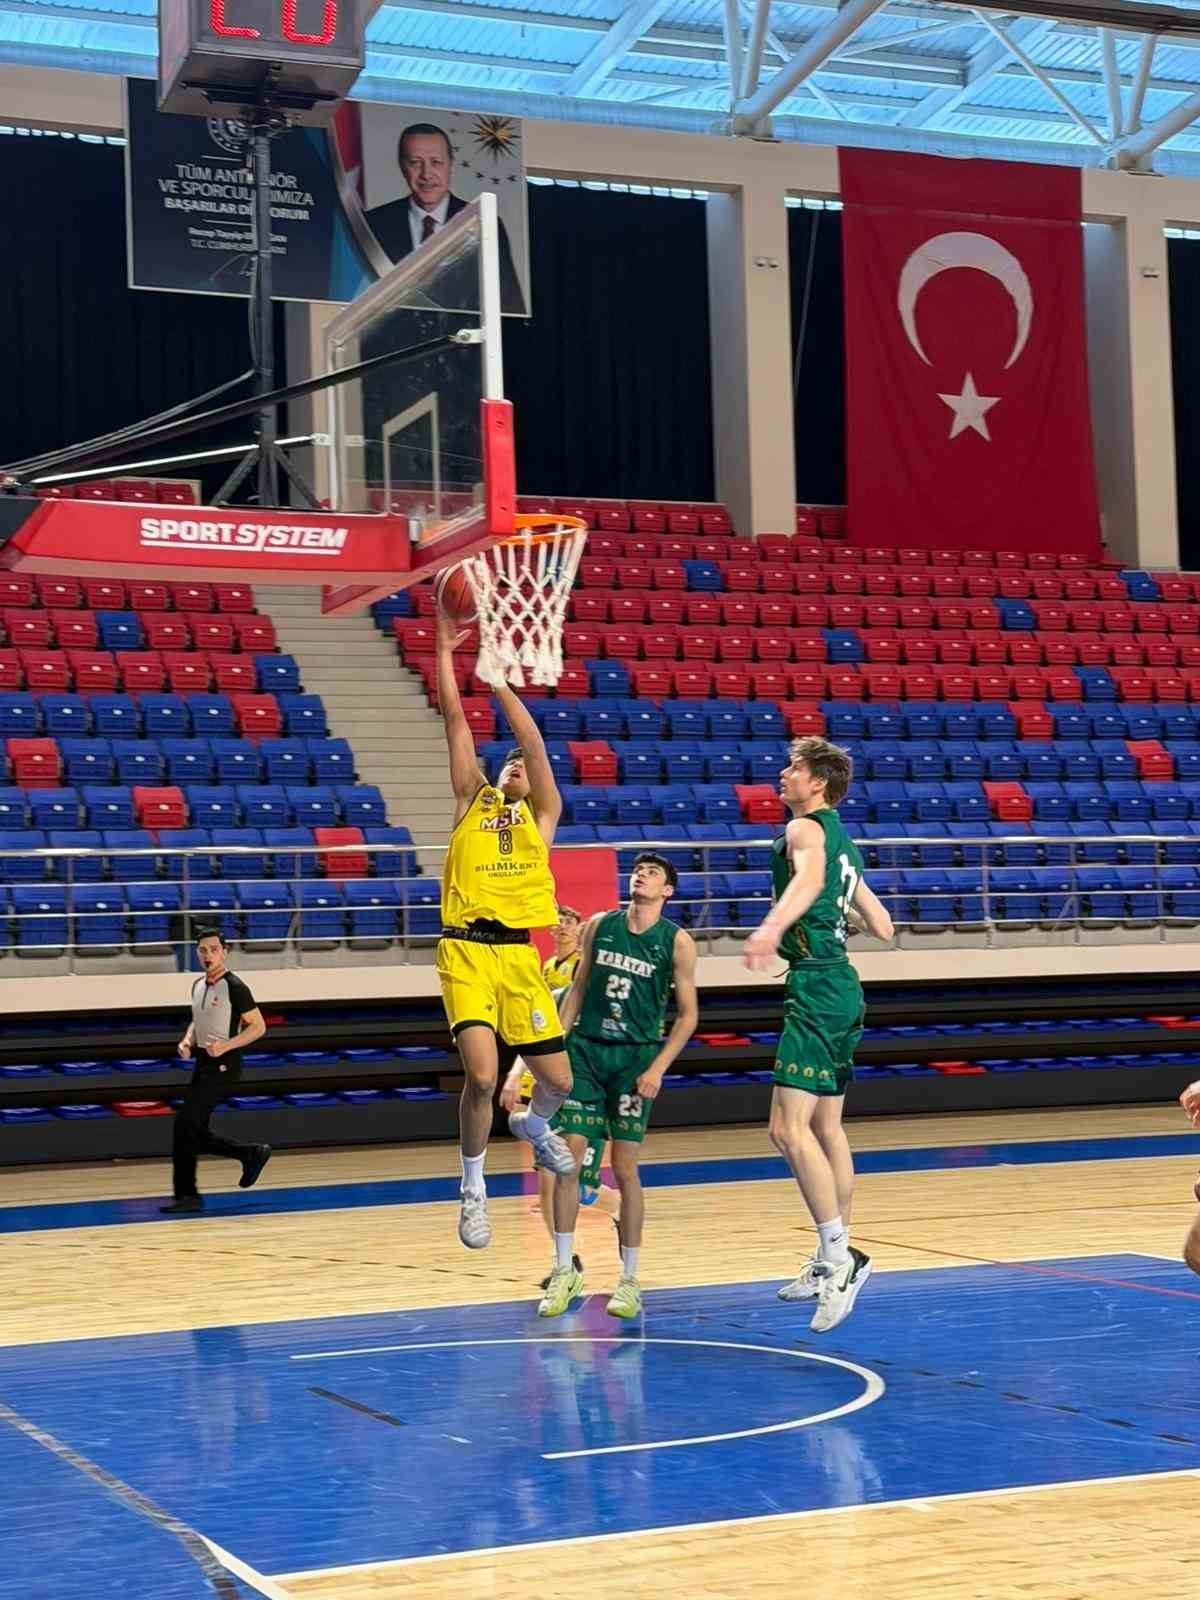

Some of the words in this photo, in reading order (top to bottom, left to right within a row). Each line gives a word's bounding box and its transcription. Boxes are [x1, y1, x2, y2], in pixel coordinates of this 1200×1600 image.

[175, 163, 212, 181] TÜM
[158, 178, 180, 194] VE
[164, 197, 237, 214] BAŞARILAR
[499, 829, 513, 855] 8
[605, 974, 632, 1000] 23
[618, 1094, 643, 1118] 23
